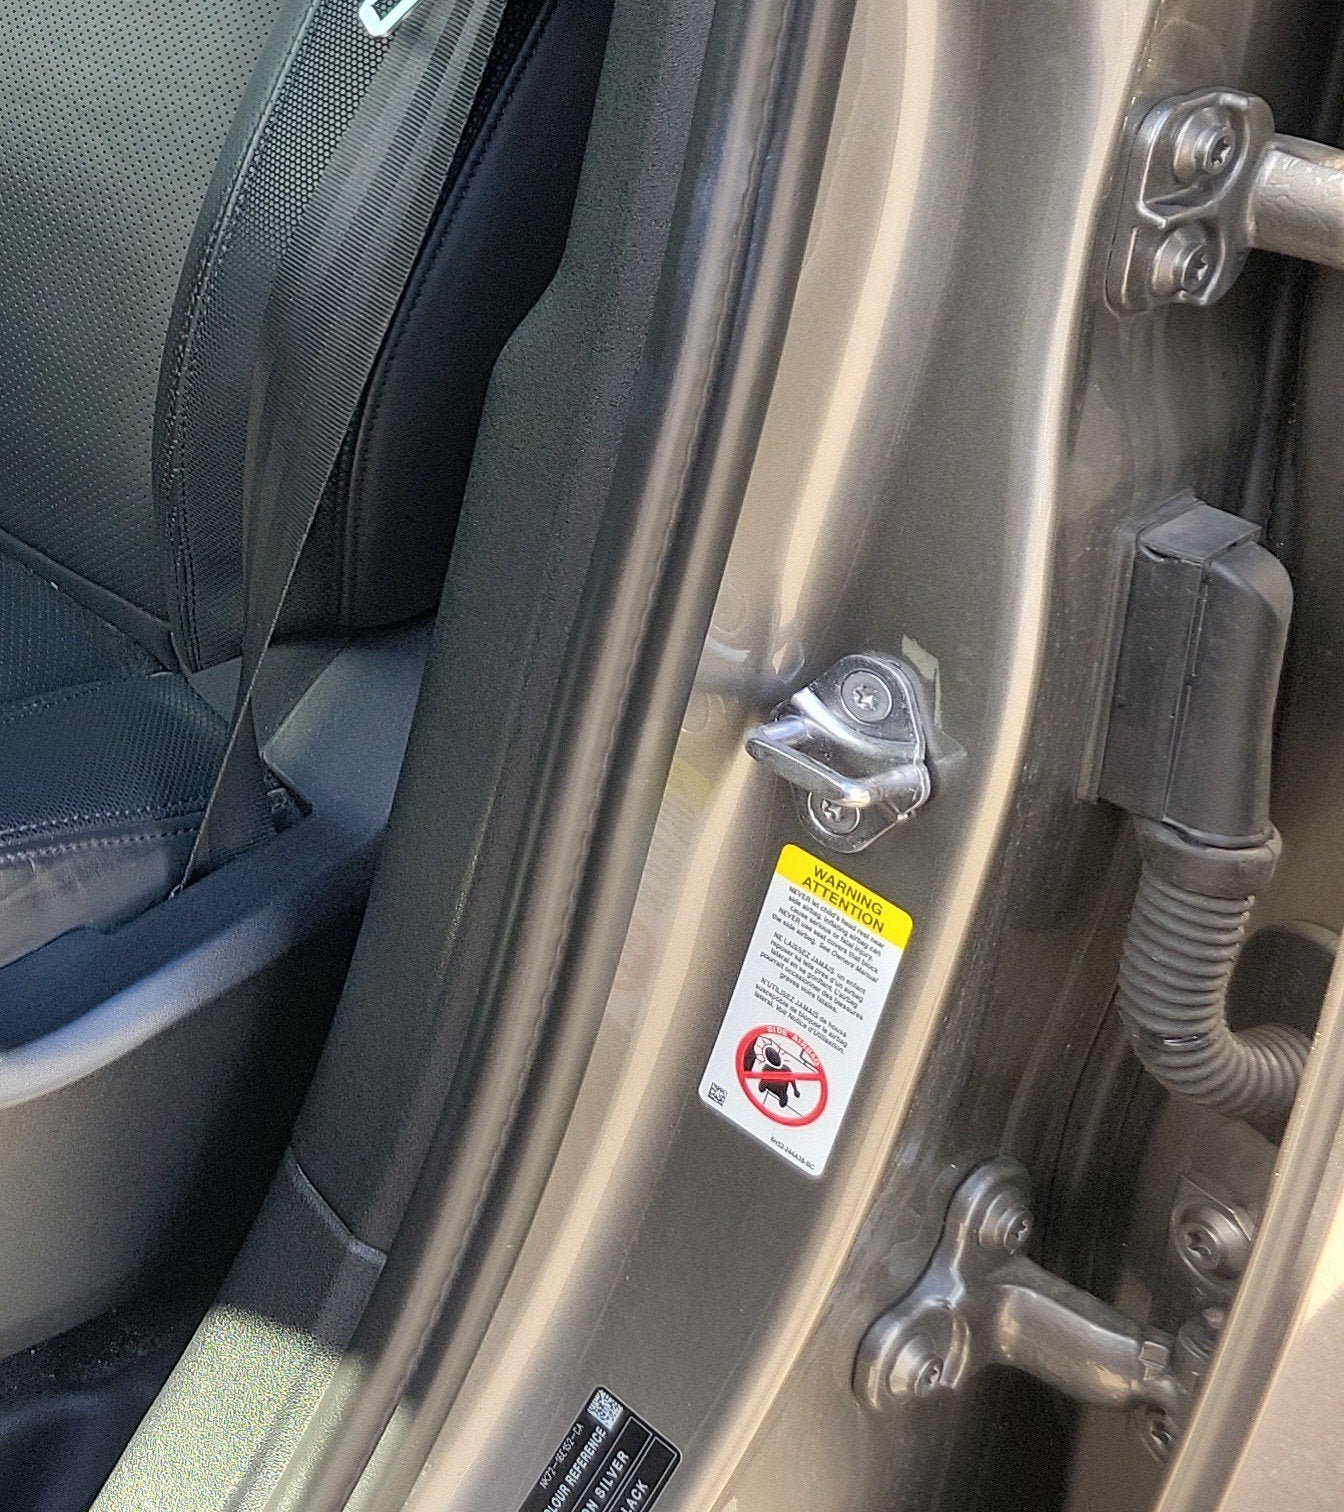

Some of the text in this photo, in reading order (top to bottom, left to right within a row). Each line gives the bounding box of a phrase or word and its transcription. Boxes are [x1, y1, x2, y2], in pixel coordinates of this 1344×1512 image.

[778, 906, 800, 924] NEVER
[788, 885, 811, 903] NEVER
[801, 876, 885, 933] ATTENTION
[813, 864, 883, 916] WARNING
[848, 932, 869, 949] airbag
[565, 1425, 607, 1485] REFERENCE
[595, 1449, 630, 1499] SILVER
